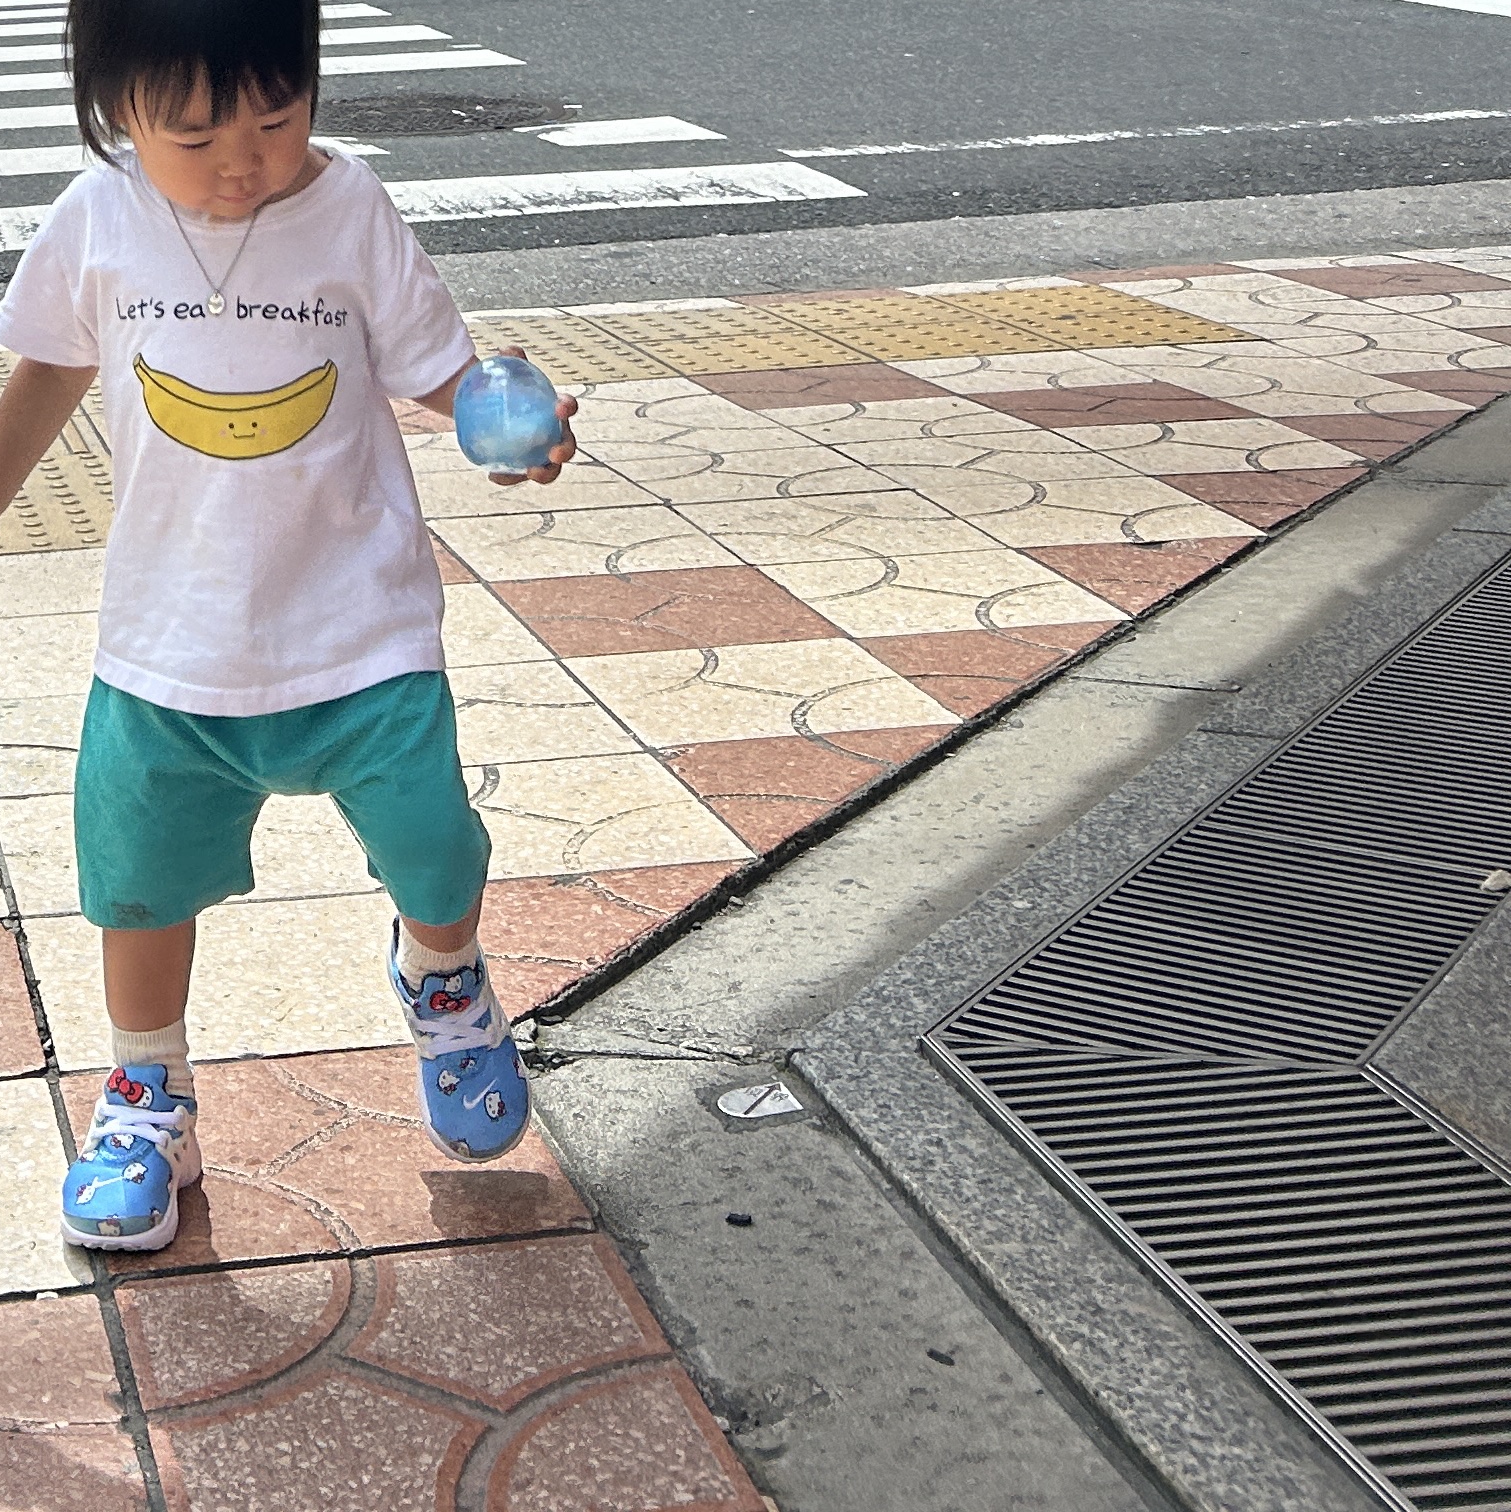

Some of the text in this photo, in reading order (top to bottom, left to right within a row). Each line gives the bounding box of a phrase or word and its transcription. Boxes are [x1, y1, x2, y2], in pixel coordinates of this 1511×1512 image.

[115, 295, 349, 328] Let's ea breakfast
